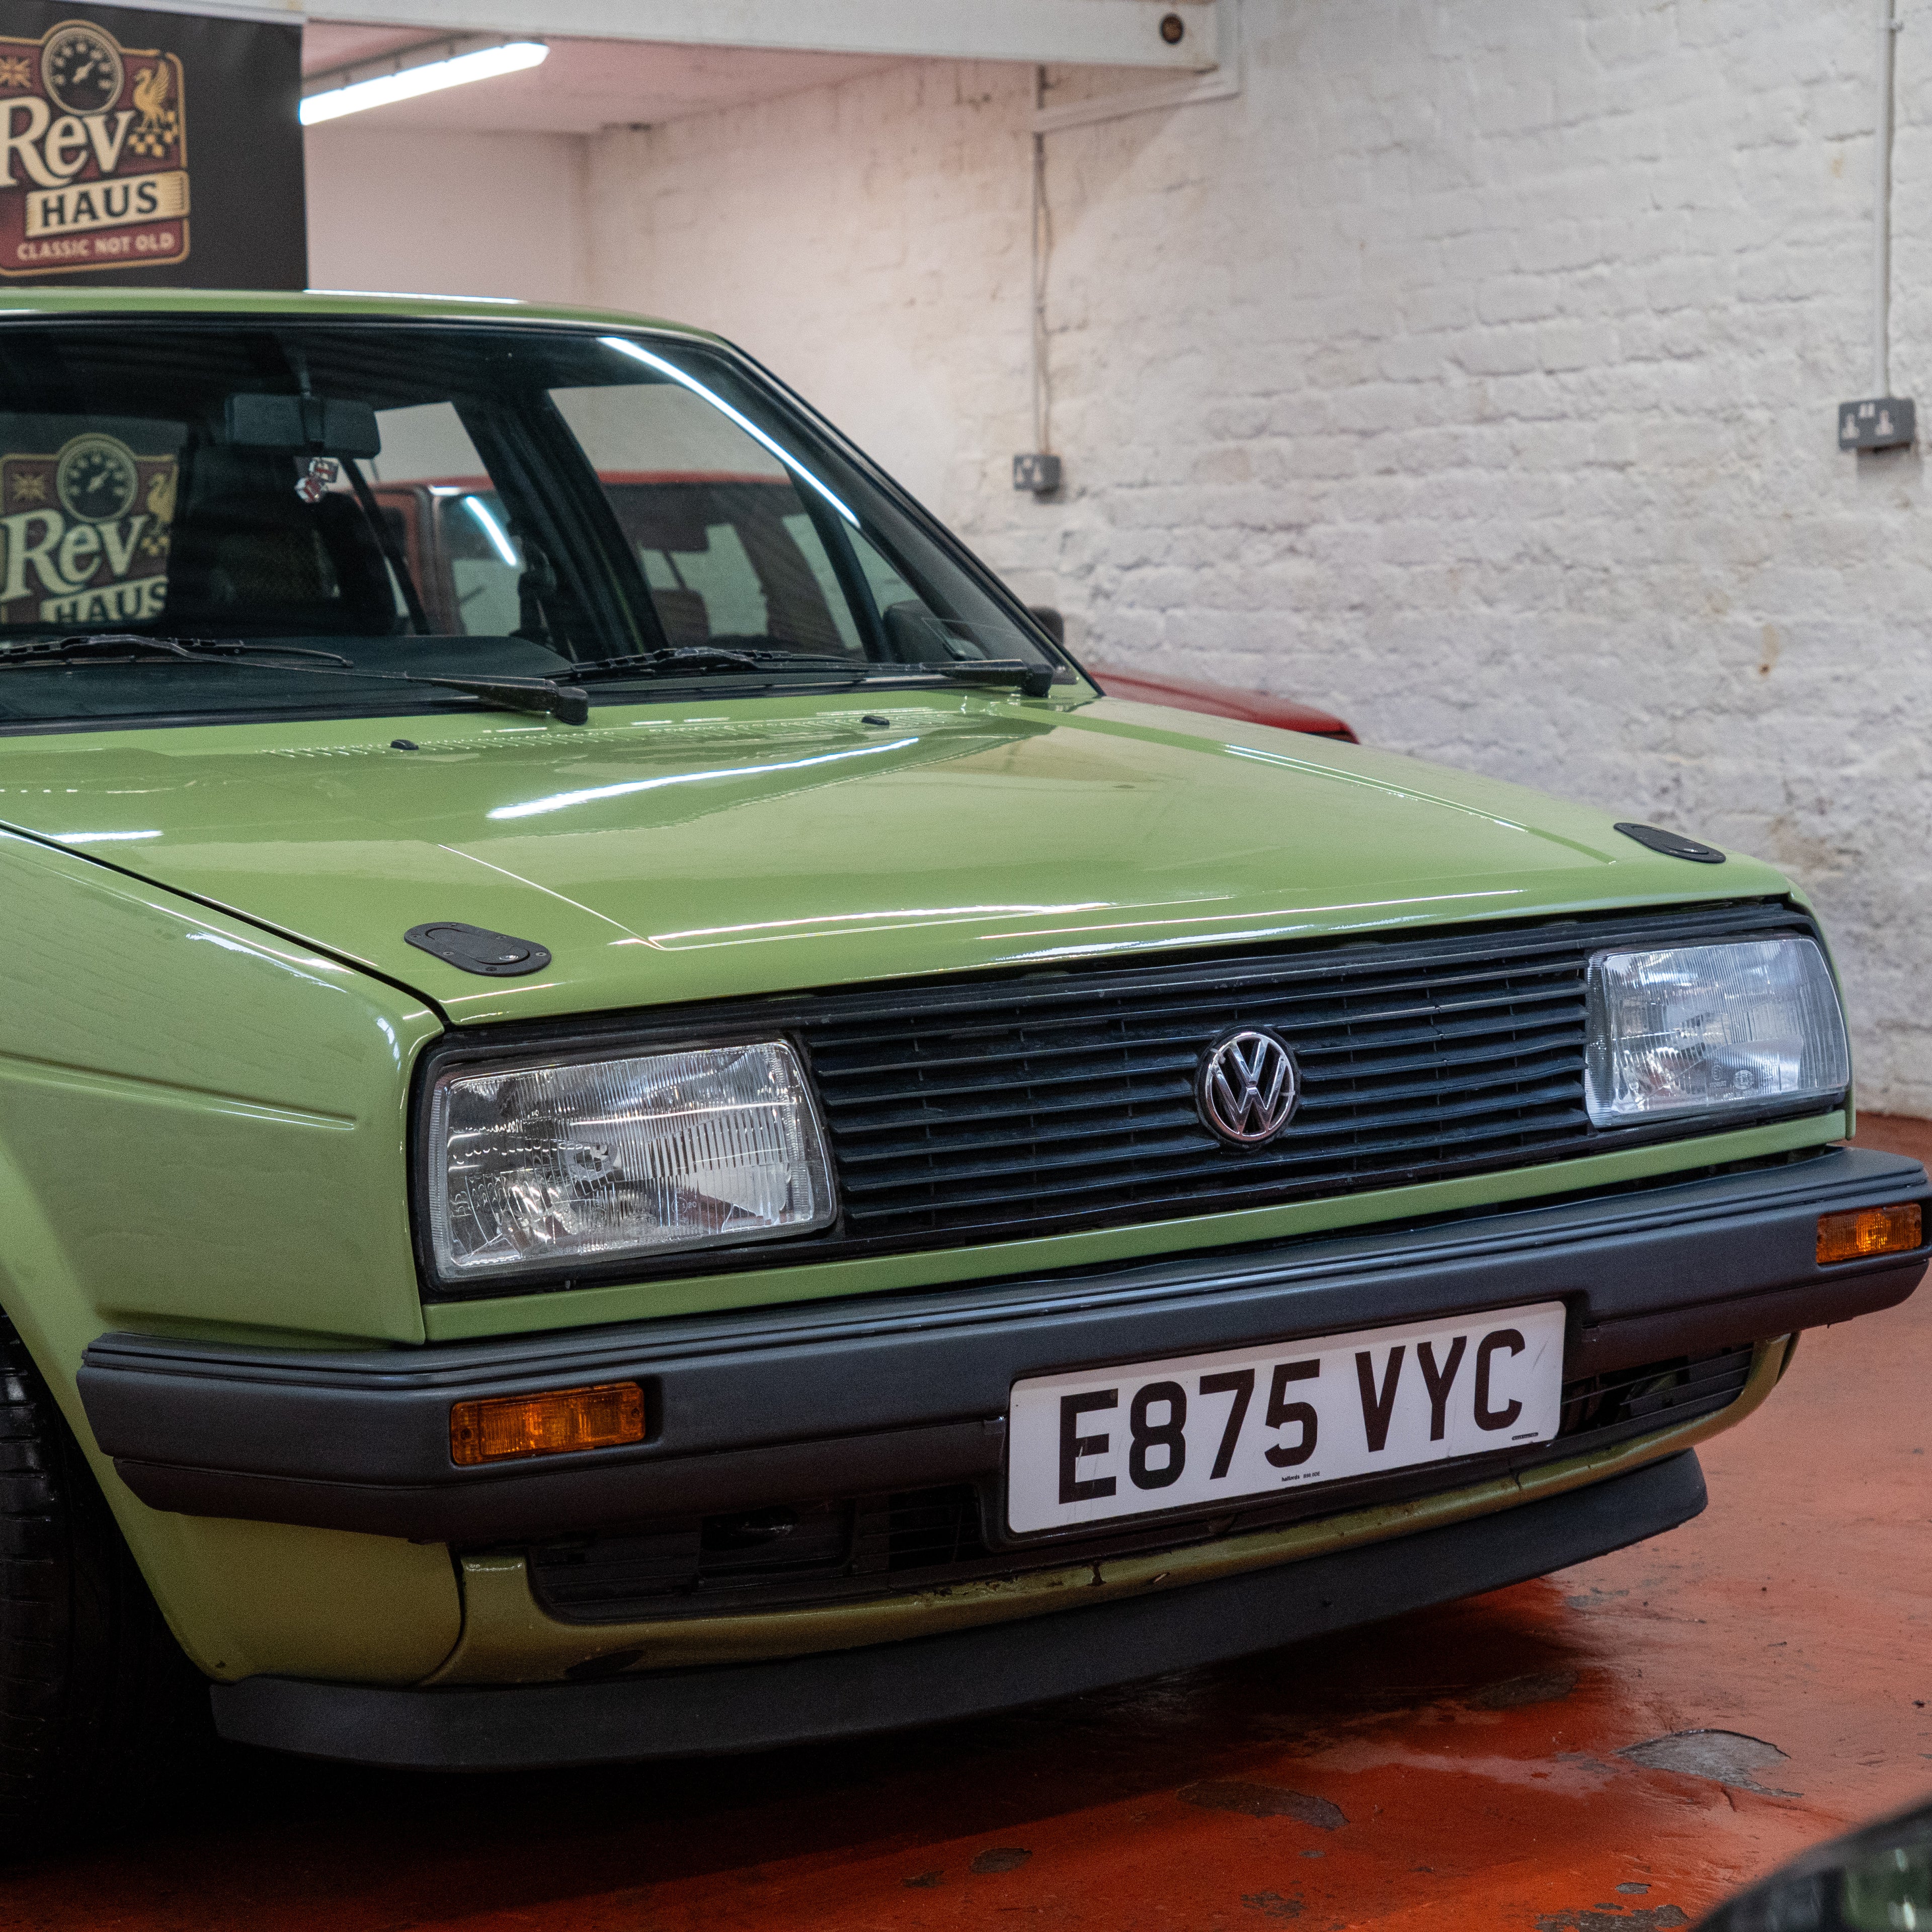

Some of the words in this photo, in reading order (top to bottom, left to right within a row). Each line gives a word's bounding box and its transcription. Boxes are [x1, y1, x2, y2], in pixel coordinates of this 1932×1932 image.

[0, 97, 135, 188] Rev
[18, 240, 90, 260] CLASSIC
[96, 238, 132, 255] NOT
[135, 232, 175, 252] OLD
[40, 182, 158, 228] HAUS
[0, 509, 148, 601] Rev
[1208, 1034, 1292, 1139] VW
[1059, 1358, 1321, 1504] E875
[1354, 1328, 1525, 1453] VYC
